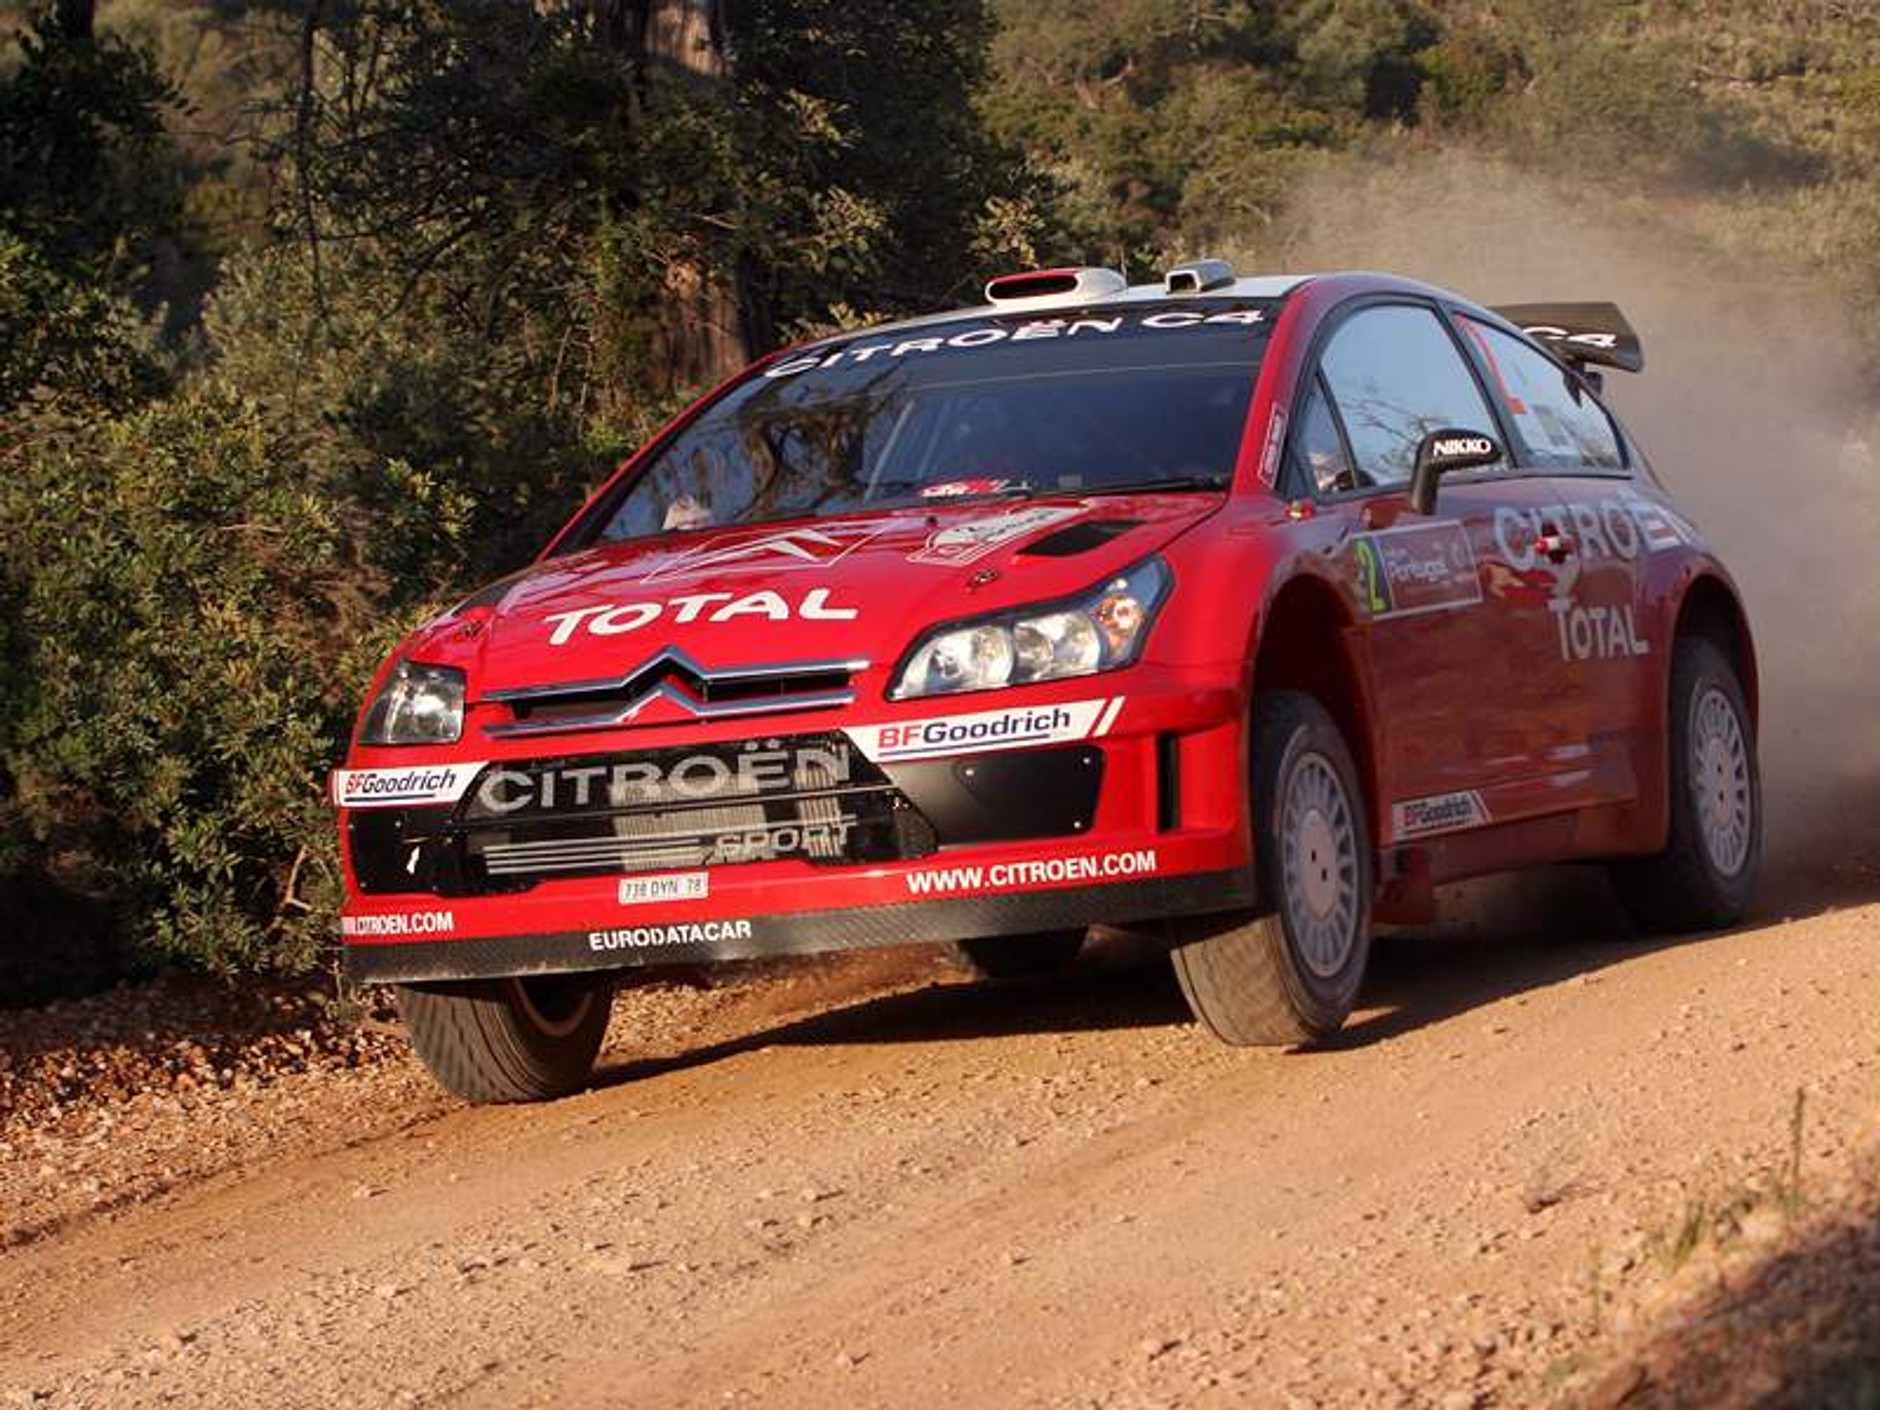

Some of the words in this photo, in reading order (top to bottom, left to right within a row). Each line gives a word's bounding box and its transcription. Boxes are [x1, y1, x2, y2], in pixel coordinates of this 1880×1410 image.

[764, 316, 1123, 378] CITROËN
[1140, 309, 1264, 329] C4
[1433, 438, 1491, 457] NIKKO
[1354, 538, 1386, 612] 2
[545, 588, 859, 646] TOTAL
[1548, 596, 1650, 661] TOTAL
[878, 706, 1071, 750] BFGoodrich
[345, 768, 457, 795] BFGoodrich
[478, 740, 852, 814] CITROËN
[714, 825, 848, 858] SPORT
[906, 849, 1157, 894] WWW.CITROEN.COM
[589, 920, 752, 951] EURODATACAR
